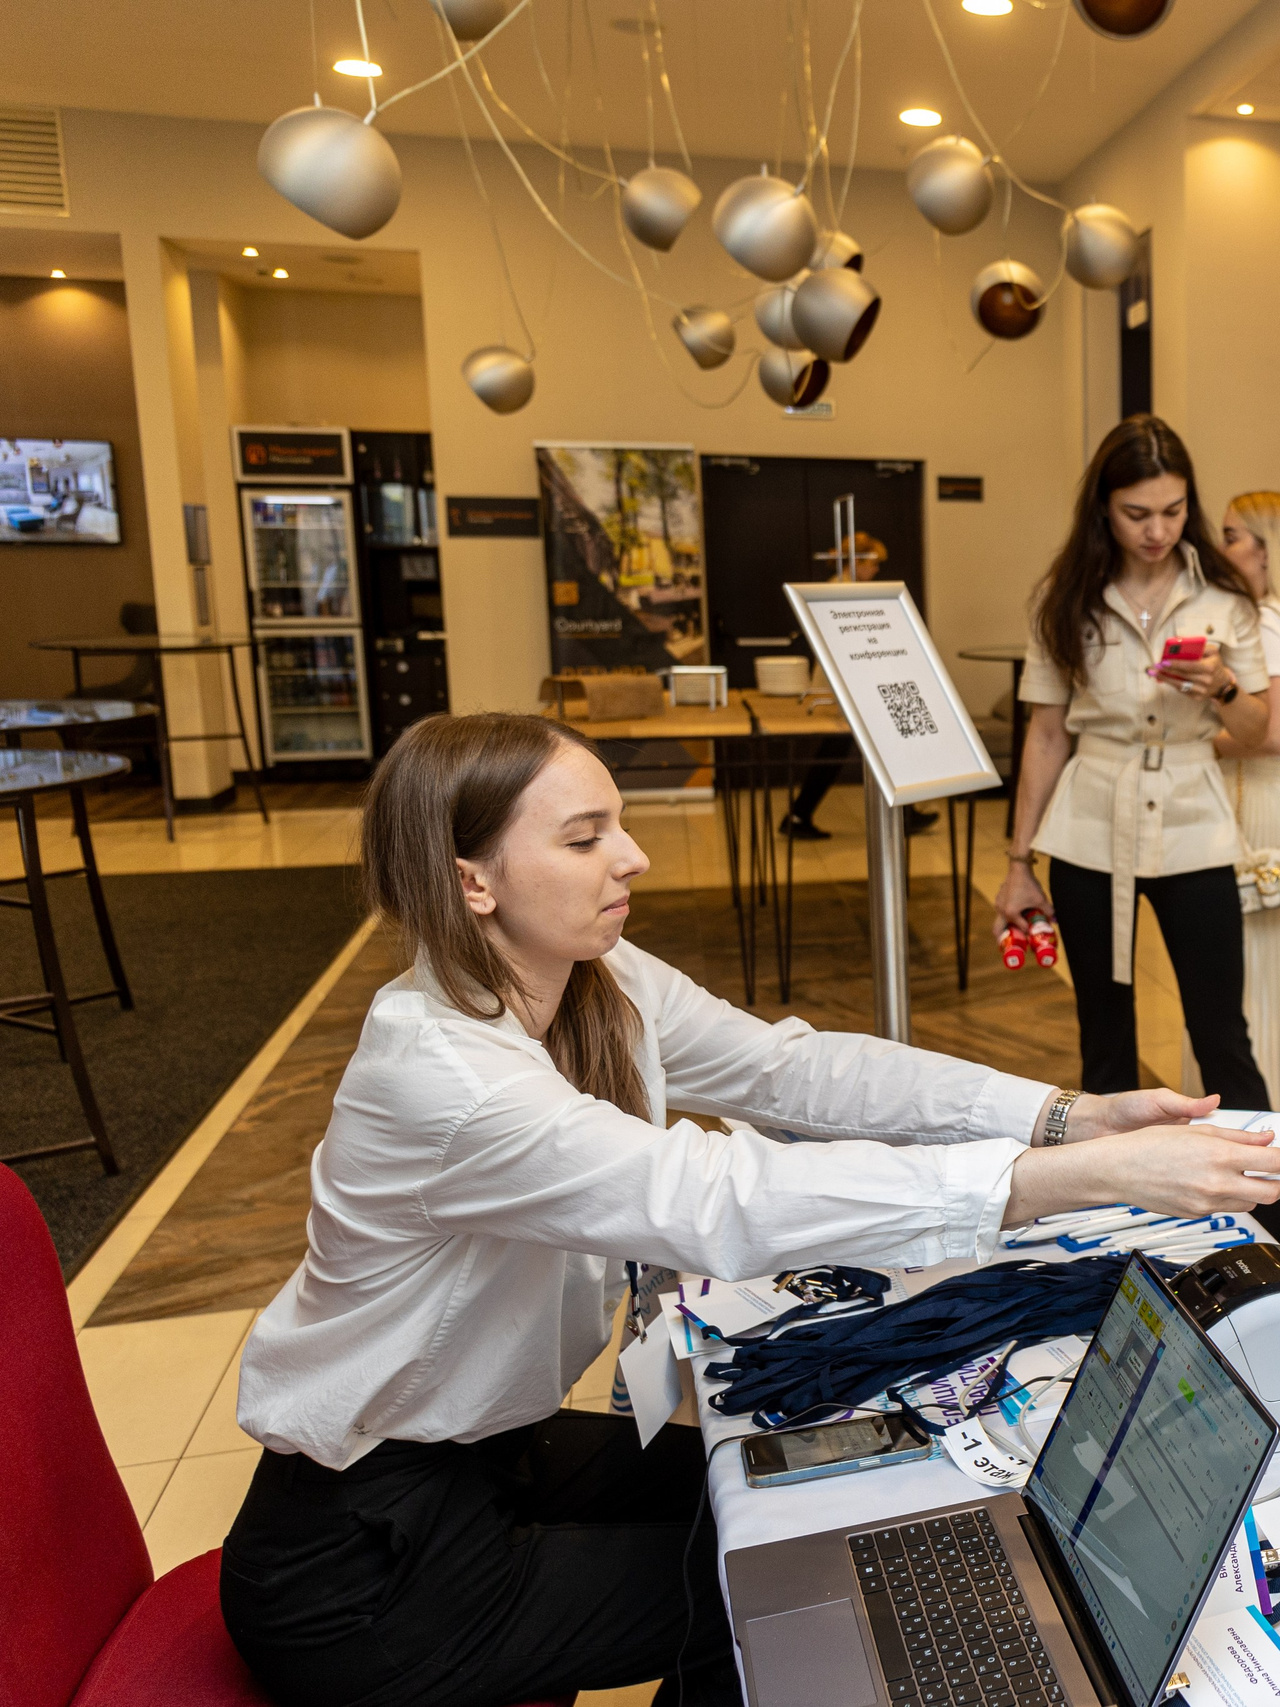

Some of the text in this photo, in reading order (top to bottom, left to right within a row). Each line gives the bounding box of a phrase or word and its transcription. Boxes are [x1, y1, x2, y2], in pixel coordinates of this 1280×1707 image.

[829, 609, 886, 620] Электронная
[838, 622, 892, 635] регистрация
[867, 637, 879, 645] на
[849, 648, 909, 661] конференцию
[960, 1431, 983, 1451] -1
[1227, 1627, 1264, 1672] Николаевна
[1227, 1645, 1258, 1685] Фёдорова
